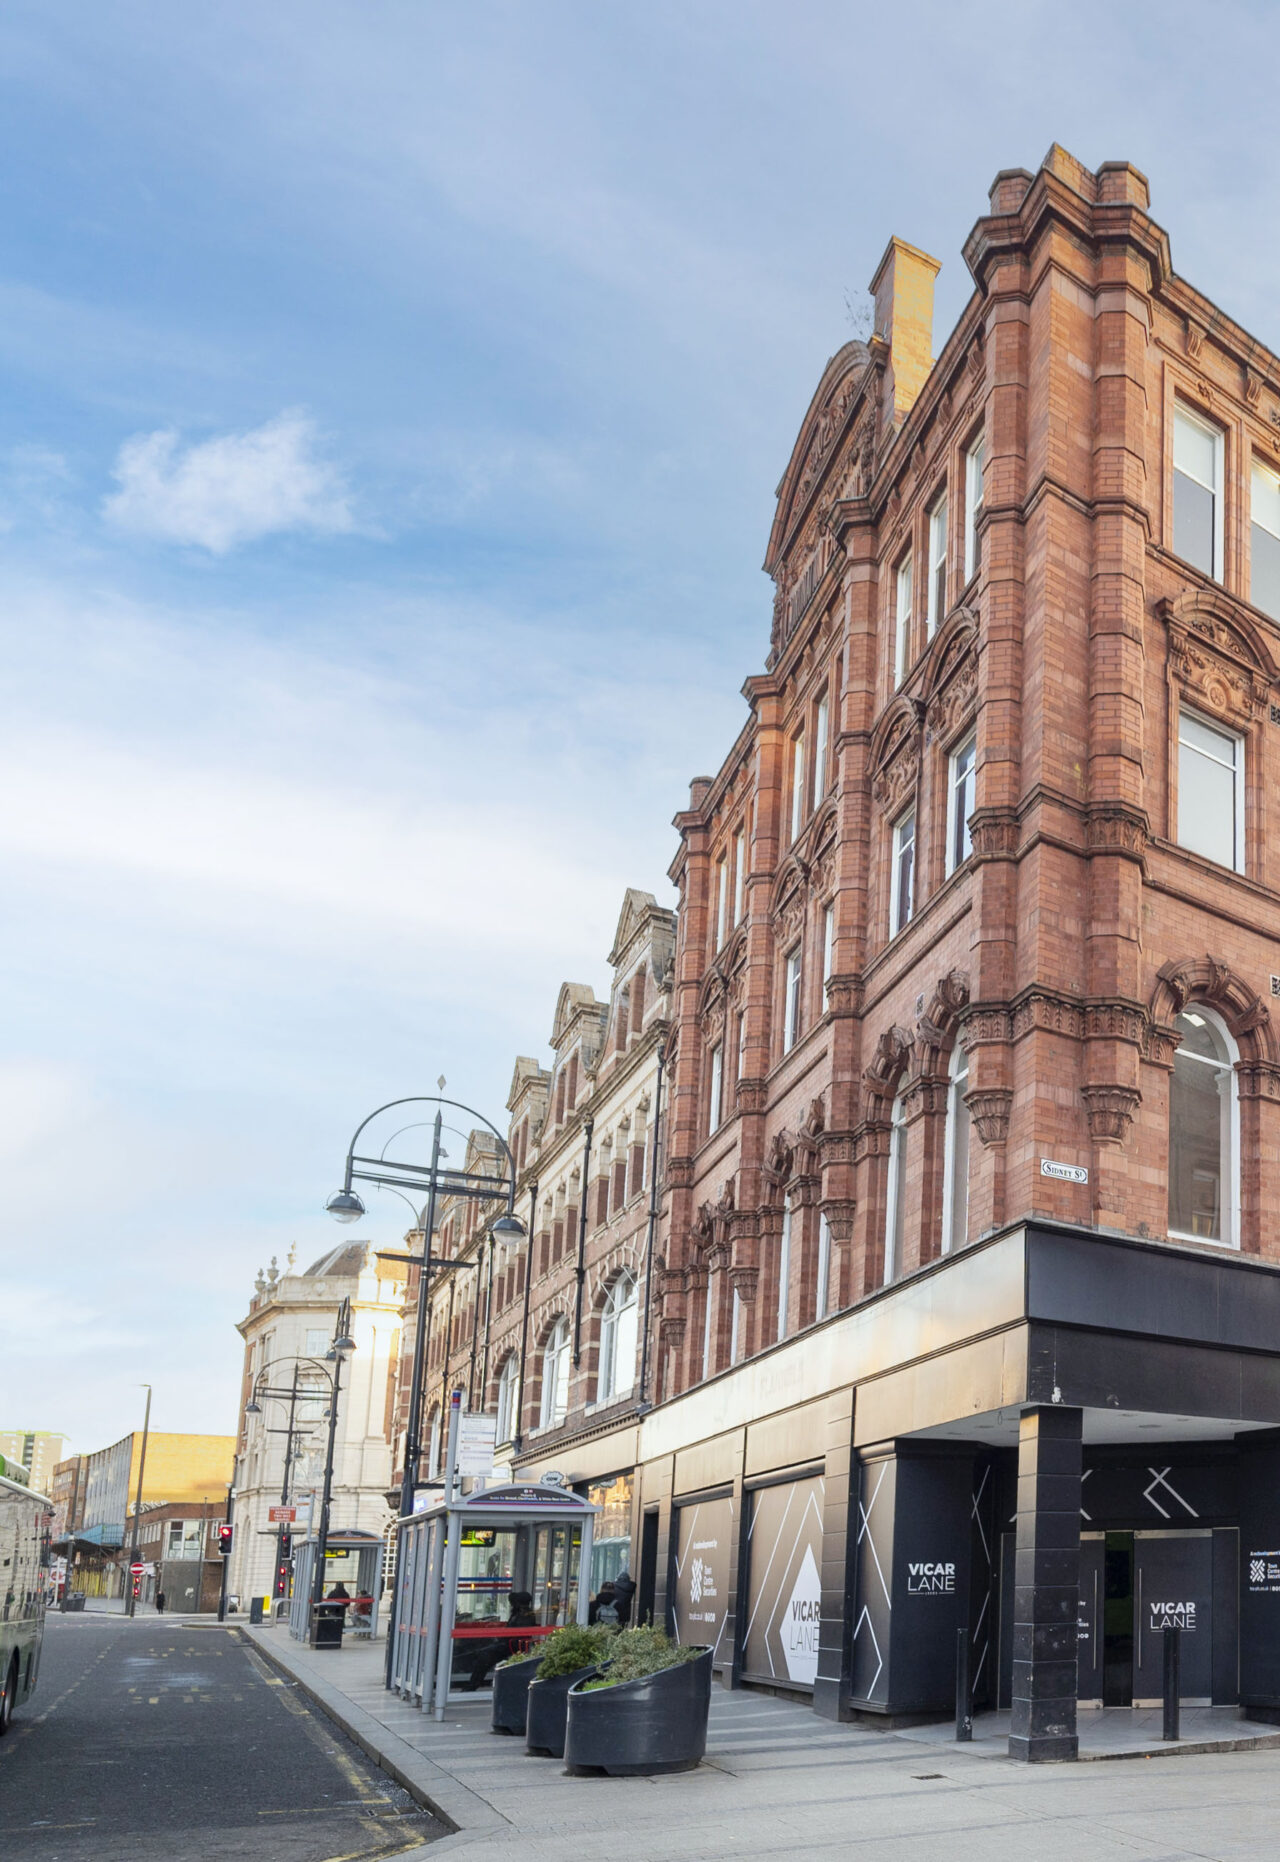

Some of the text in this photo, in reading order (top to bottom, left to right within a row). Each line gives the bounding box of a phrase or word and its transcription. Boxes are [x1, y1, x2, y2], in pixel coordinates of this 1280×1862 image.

[908, 1563, 956, 1576] VICAR
[908, 1576, 956, 1591] LANE
[792, 1601, 821, 1622] VICAR
[1150, 1602, 1196, 1615] VICAR
[1150, 1614, 1196, 1629] LANE
[790, 1626, 820, 1653] LANE
